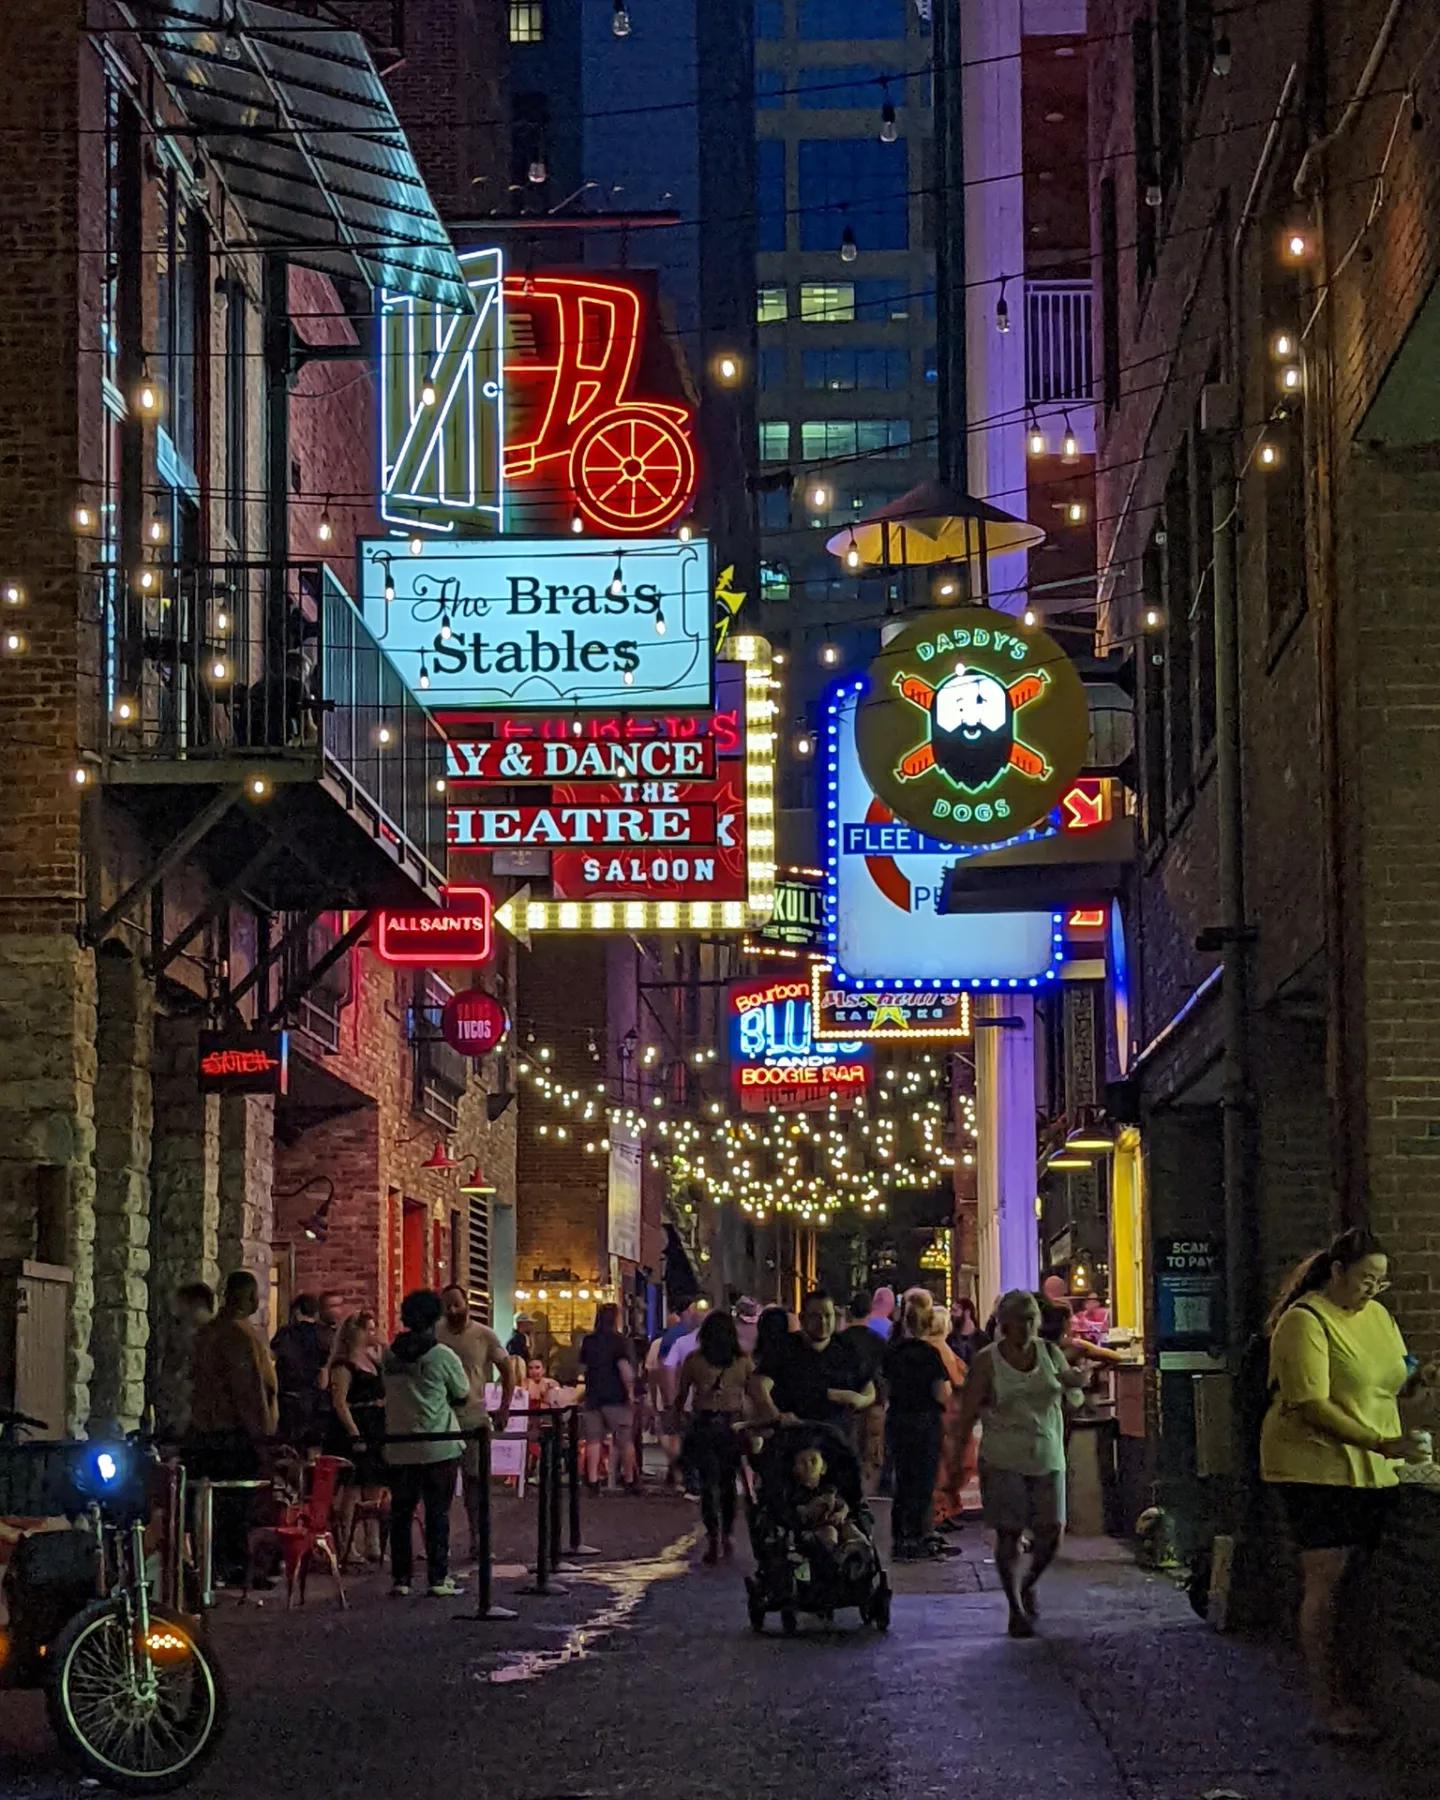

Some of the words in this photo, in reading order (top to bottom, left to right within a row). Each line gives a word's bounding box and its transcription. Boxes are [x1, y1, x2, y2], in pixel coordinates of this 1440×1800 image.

[411, 574, 492, 622] The
[506, 576, 660, 615] Brass
[433, 629, 641, 674] Stables
[916, 628, 1028, 661] DADDY'S
[500, 742, 532, 776] &
[544, 742, 703, 777] DANCE
[618, 782, 679, 802] THE
[932, 799, 1010, 822] DOGS
[584, 859, 715, 881] SALOON
[387, 916, 484, 932] ALLSAINTS
[736, 984, 810, 1013] Bourbon
[835, 1009, 943, 1021] KAROKE
[740, 1000, 863, 1055] BLU
[742, 1067, 819, 1085] BOOGIE
[822, 1065, 865, 1083] BAR
[1172, 1242, 1209, 1253] SCAN
[1166, 1256, 1185, 1267] TO
[1188, 1256, 1214, 1267] PAY
